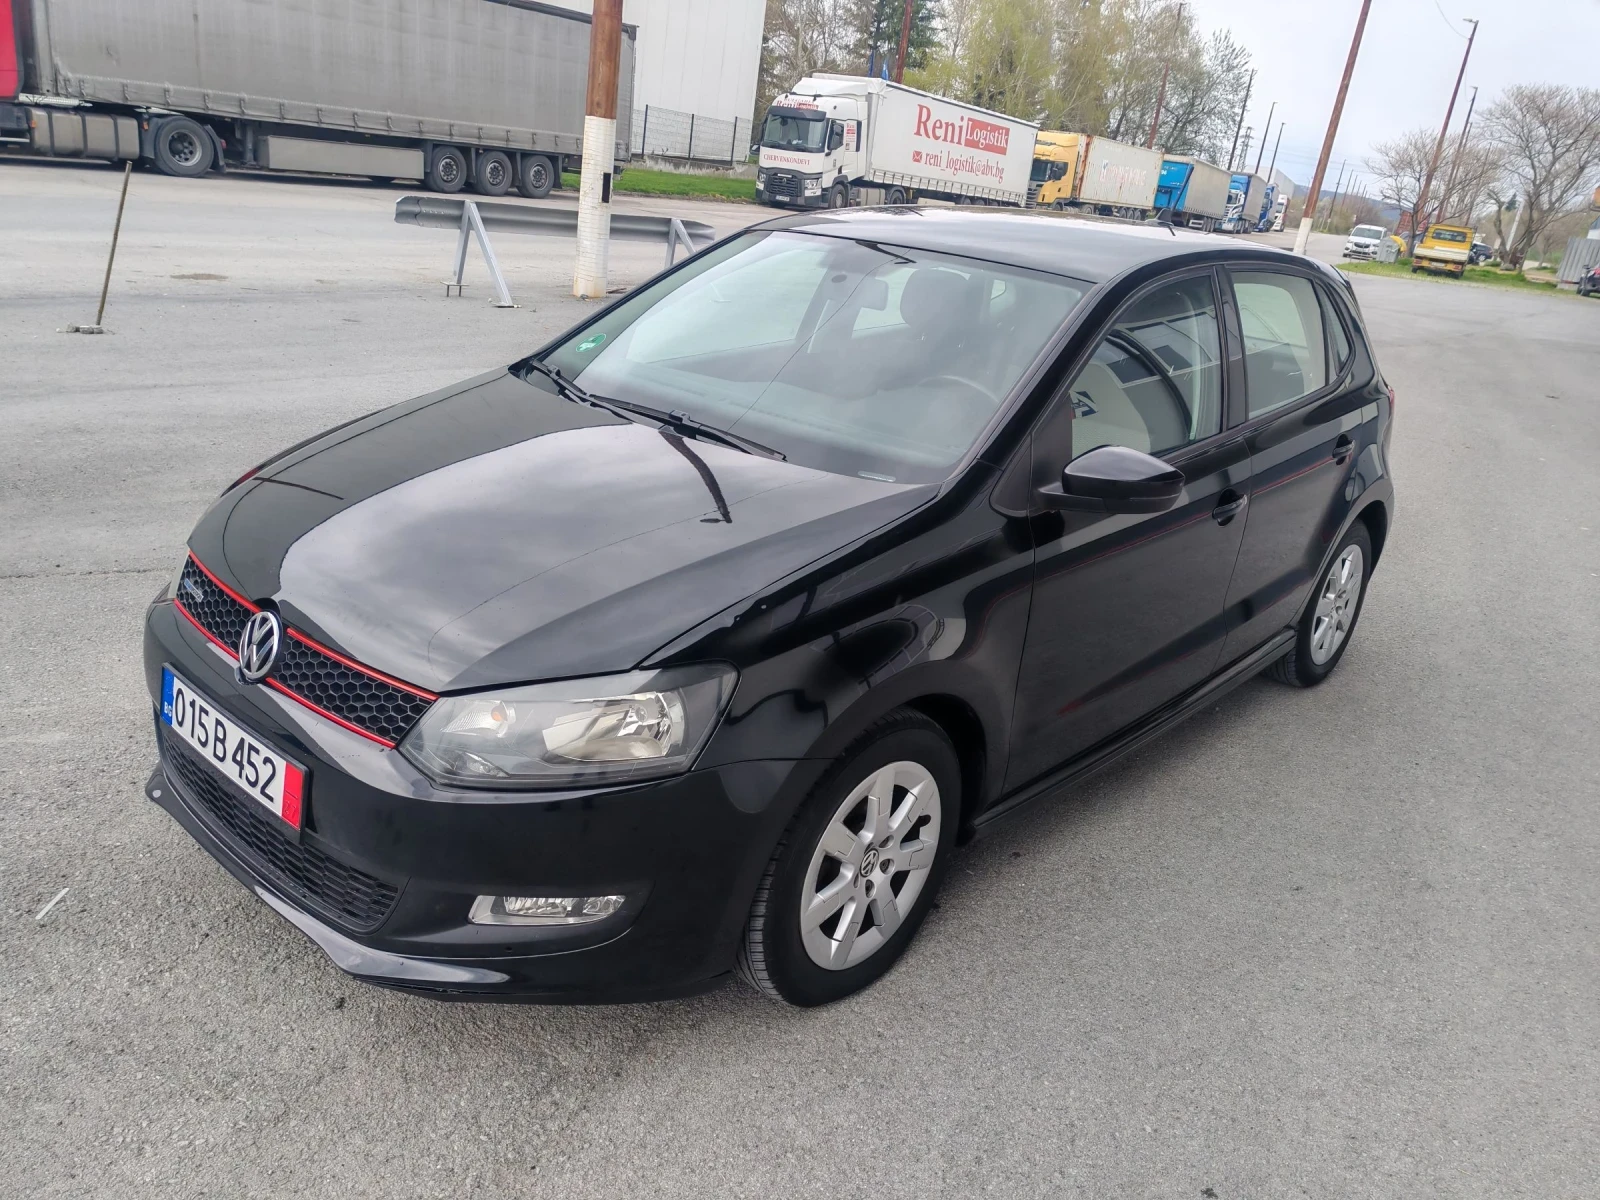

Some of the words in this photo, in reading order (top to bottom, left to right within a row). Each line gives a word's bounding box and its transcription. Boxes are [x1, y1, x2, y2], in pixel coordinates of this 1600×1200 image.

[914, 103, 965, 146] Reni
[966, 120, 1008, 148] Logistik
[924, 150, 1005, 184] reni_logistik@abv.bg
[164, 701, 173, 717] BG
